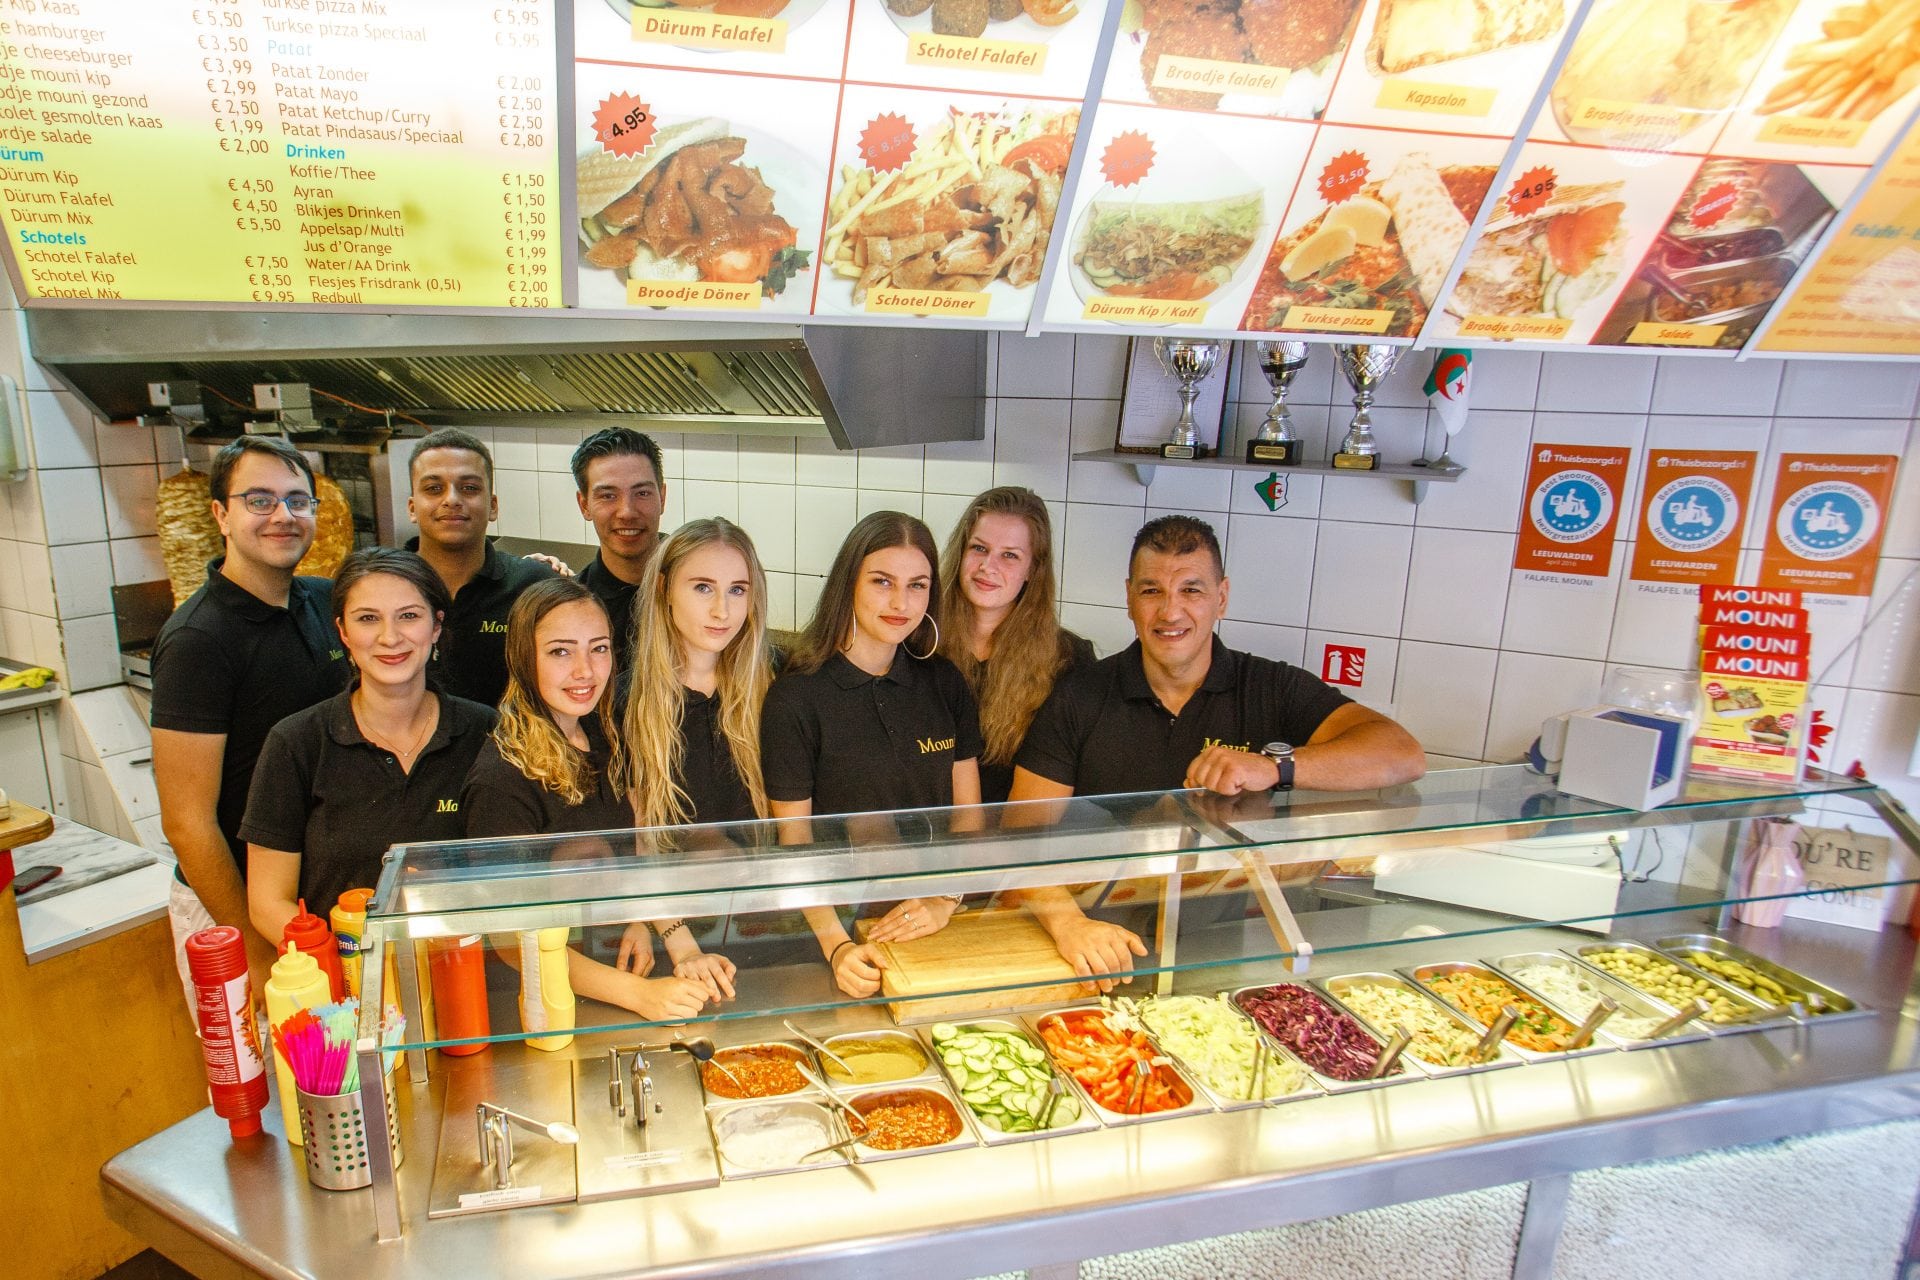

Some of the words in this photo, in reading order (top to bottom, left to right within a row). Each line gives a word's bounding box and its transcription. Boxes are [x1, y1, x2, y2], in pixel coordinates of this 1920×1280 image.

[361, 1, 388, 16] Mix
[207, 10, 243, 27] 5,50
[15, 20, 106, 45] hamburger
[263, 16, 313, 34] Turkse
[319, 24, 359, 38] pizza
[645, 18, 706, 39] Dürum
[711, 24, 774, 44] Falafel
[211, 36, 248, 53] 3,50
[24, 43, 133, 68] cheeseburger
[917, 42, 978, 63] Schotel
[980, 48, 1038, 67] Falafel
[215, 58, 252, 75] 3,99
[271, 62, 312, 79] Patat
[317, 66, 370, 82] Zonder
[31, 69, 81, 84] mouni
[85, 69, 111, 88] kip
[1166, 66, 1226, 88] Broodje
[1228, 70, 1279, 89] falafel
[222, 80, 256, 96] 2,99
[275, 83, 315, 99] Patat
[320, 87, 358, 103] Mayo
[37, 90, 87, 104] mouni
[92, 94, 149, 109] gezond
[1405, 92, 1467, 108] Kapsalon
[226, 100, 259, 116] 2,50
[278, 103, 317, 119] Patat
[41, 111, 123, 126] gesmolten
[127, 113, 163, 129] kaas
[231, 119, 264, 135] 1,99
[512, 116, 542, 131] 2,50
[41, 129, 92, 144] salade
[282, 122, 322, 138] Patat
[233, 139, 269, 154] 2,00
[513, 134, 543, 148] 2,80
[286, 144, 346, 160] Drinken
[0, 167, 49, 182] Dürum
[53, 170, 79, 187] Kip
[516, 174, 544, 189] 1,50
[242, 179, 274, 194] 4,50
[293, 185, 334, 200] Ayran
[4, 189, 56, 204] Dürum
[60, 191, 114, 206] Falafel
[517, 193, 545, 208] 1,50
[246, 199, 278, 214] 4,50
[296, 204, 344, 219] Blikjes
[347, 206, 401, 219] Drinken
[11, 209, 62, 223] Dürum
[67, 211, 93, 225] Mix
[250, 217, 281, 232] 5,50
[517, 212, 546, 226] 1,50
[20, 230, 86, 245] Schotels
[518, 229, 546, 243] 1,99
[303, 240, 325, 252] Jus
[519, 247, 546, 260] 1,99
[25, 250, 81, 263] Schotel
[85, 251, 137, 265] Falafel
[257, 256, 288, 270] 7,50
[376, 260, 412, 272] Drink
[520, 264, 547, 277] 1,99
[32, 269, 88, 282] Schotel
[91, 270, 115, 285] Kip
[262, 274, 292, 288] 8,50
[309, 276, 356, 290] Flesjes
[360, 276, 422, 290] Frisdrank
[38, 286, 94, 299] Schotel
[97, 287, 122, 300] Mix
[520, 281, 548, 294] 2,00
[637, 286, 697, 305] Broodje
[703, 286, 751, 303] Döner
[312, 292, 363, 304] Redbull
[876, 293, 928, 309] Schotel
[931, 296, 976, 310] Döner
[1090, 303, 1134, 317] Dürum
[1137, 305, 1160, 319] Kip
[1170, 306, 1200, 318] Kalf
[1302, 314, 1342, 327] Turkse
[1344, 316, 1375, 328] pizza
[1464, 321, 1507, 335] Broodje
[1510, 322, 1545, 335] Döner
[1547, 326, 1564, 338] kip
[1658, 328, 1695, 340] Salade
[1540, 477, 1559, 493] Best
[1532, 549, 1594, 561] LEEUWARDEN
[1651, 559, 1718, 570] LEEUWARDEN
[1524, 573, 1559, 584] FALAFEL
[1561, 577, 1593, 587] MOUNI
[1638, 584, 1681, 596] FALAFEL
[1713, 588, 1791, 606] MOUNI
[1715, 609, 1796, 629] MOUNI
[1715, 634, 1798, 655] MOUNI
[1715, 656, 1799, 677] MOUNI
